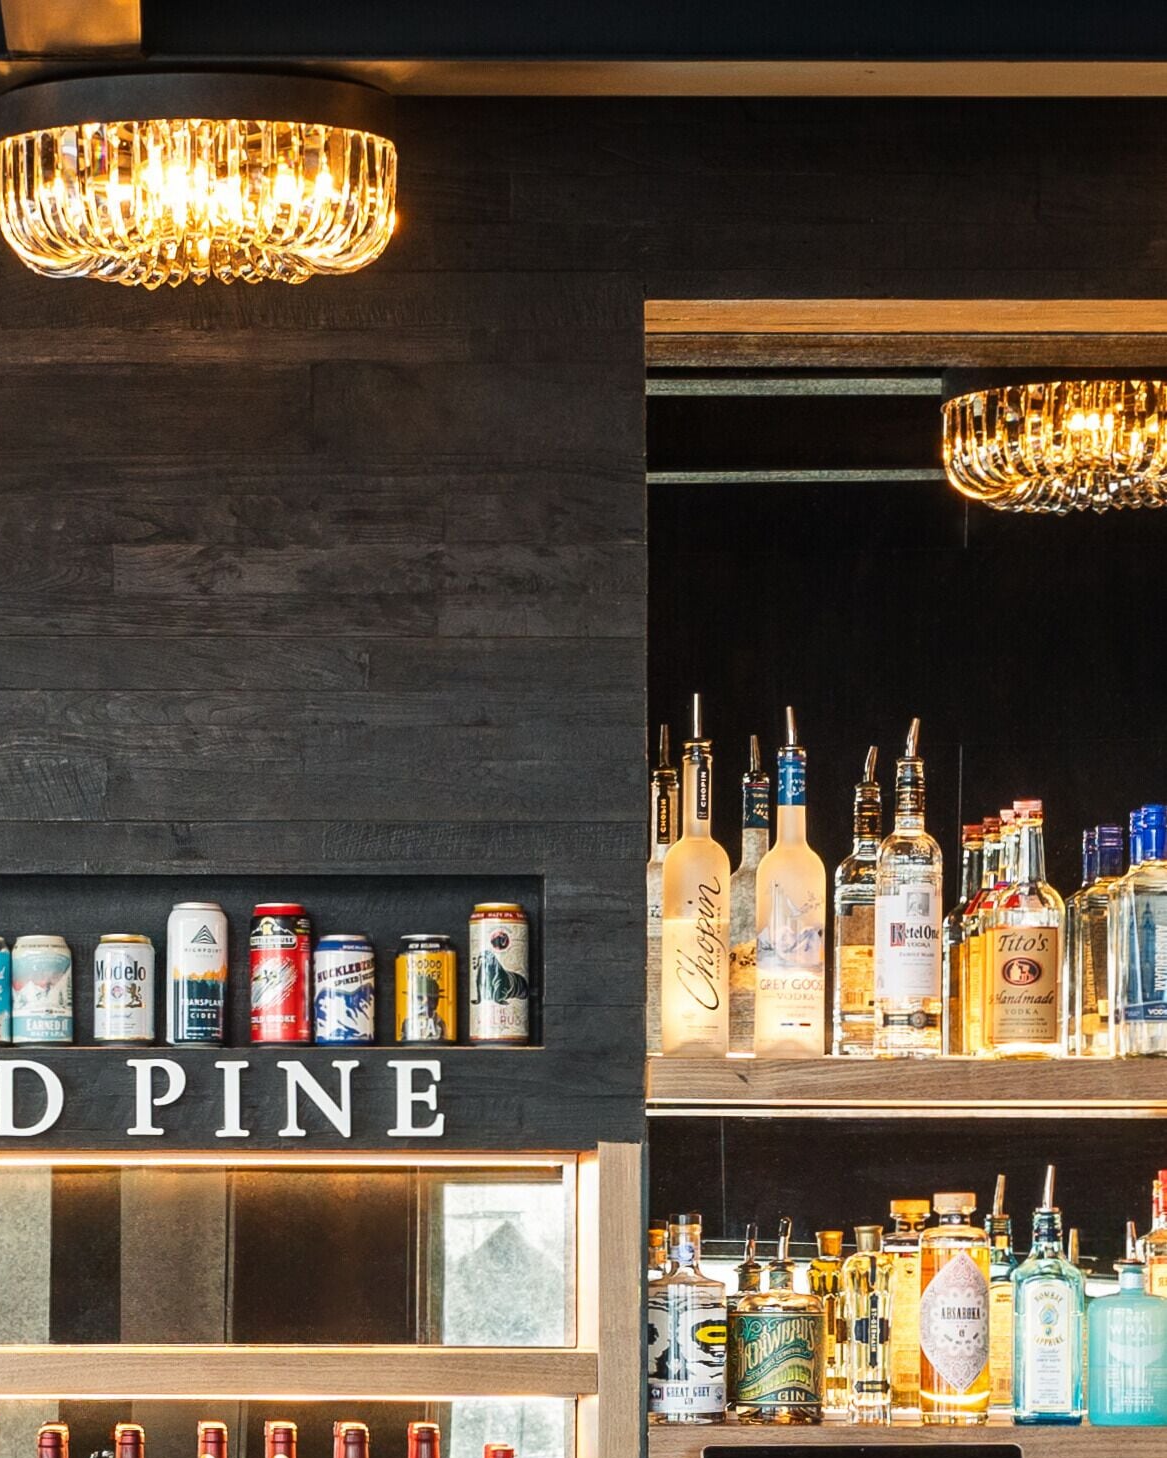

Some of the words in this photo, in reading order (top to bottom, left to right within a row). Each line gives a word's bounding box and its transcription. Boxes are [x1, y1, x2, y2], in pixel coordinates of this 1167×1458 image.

[891, 923, 923, 947] Ketel
[924, 925, 939, 940] One
[676, 876, 726, 1011] Chopin
[96, 960, 147, 981] Modelo
[759, 979, 787, 991] GREY
[791, 979, 823, 991] GOOS
[180, 998, 224, 1007] ANSPLANT
[988, 990, 1054, 1005] Handmade
[1005, 1007, 1039, 1015] VODKA
[125, 1058, 445, 1138] PINE
[941, 1307, 981, 1320] ABSAROKA
[1110, 1324, 1155, 1336] WHAL
[666, 1386, 690, 1397] GREAT
[777, 1390, 806, 1401] GIN
